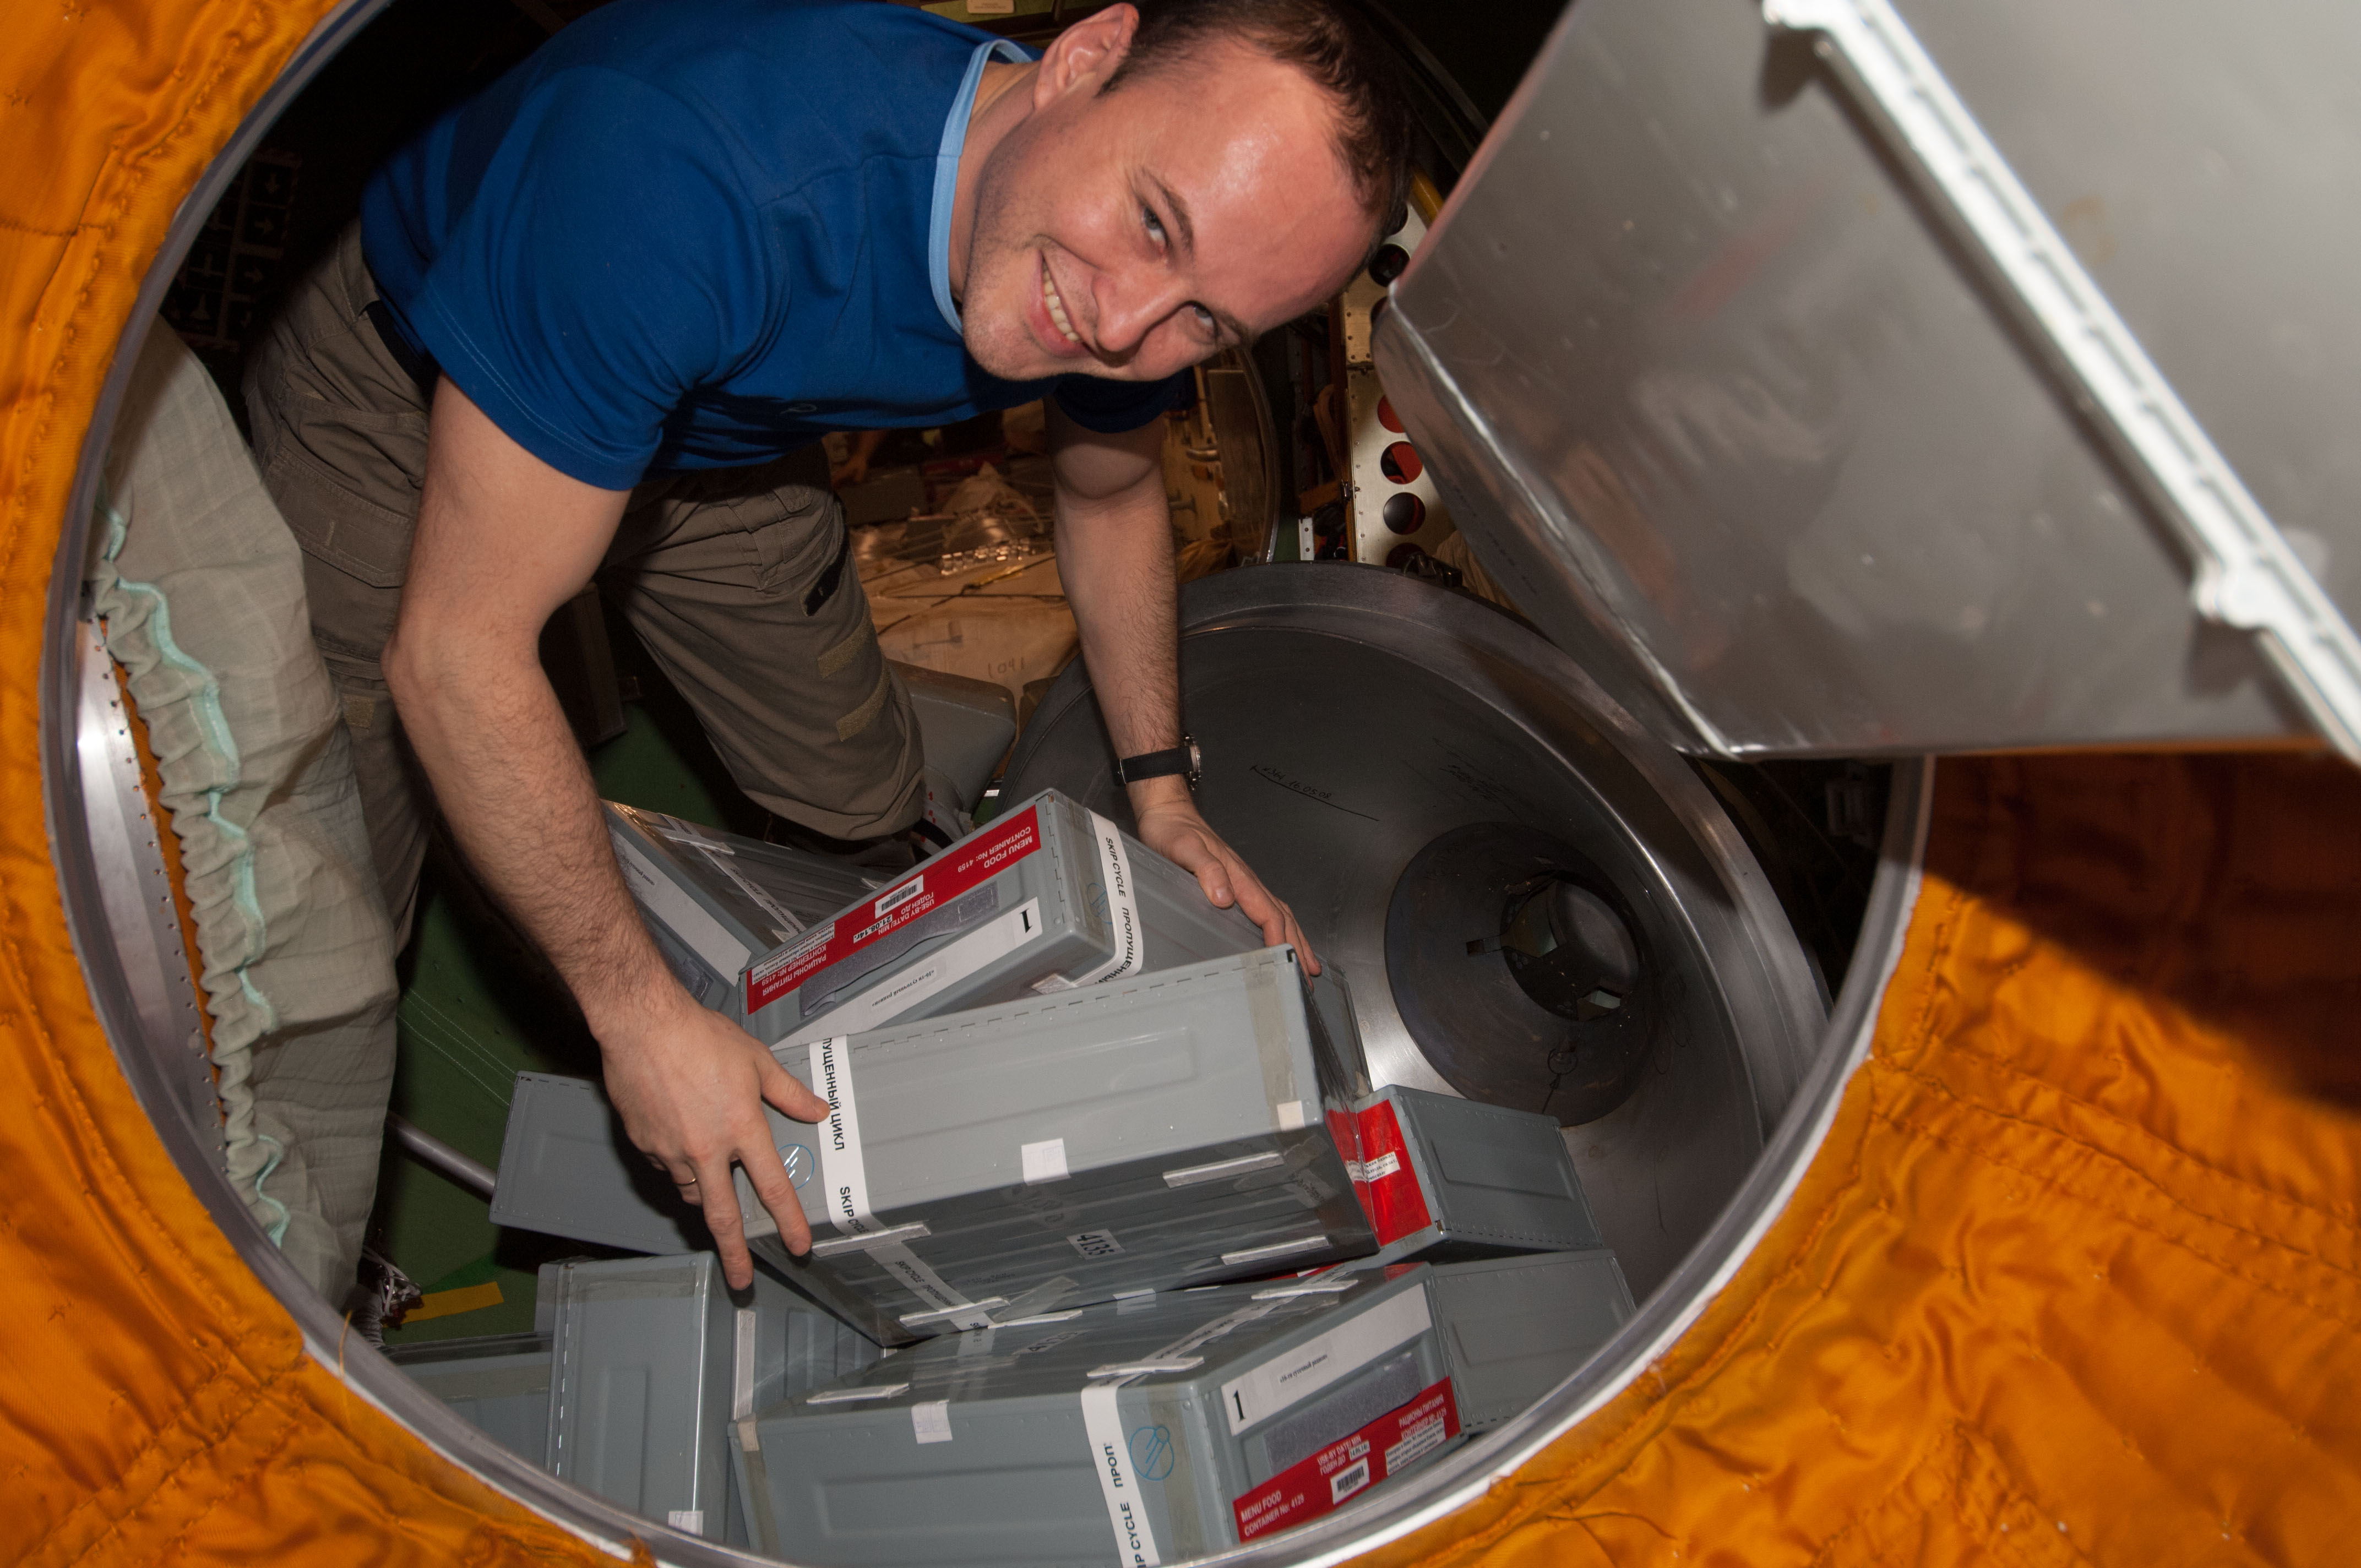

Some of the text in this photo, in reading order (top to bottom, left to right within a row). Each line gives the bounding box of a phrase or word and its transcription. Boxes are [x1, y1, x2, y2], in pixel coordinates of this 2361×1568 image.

[957, 826, 1030, 872] CONTAINER No: 4159
[983, 835, 1032, 868] MENU FOOD
[1105, 837, 1126, 897] SKIP CYCLE
[901, 903, 911, 914] ДО
[911, 891, 933, 908] ГОДЕН
[855, 916, 890, 940] 21.08.14г.
[878, 898, 934, 935] USE-BY DATE/ MIN
[1020, 908, 1035, 934] 1
[787, 944, 826, 972] КОНТЕЙНЕР
[761, 973, 776, 986] 4159
[762, 953, 826, 996] РАЦИОНЫ ПИТАНИЯ
[893, 978, 918, 996] суточный
[830, 1112, 845, 1151] ЦИКЛ
[839, 1186, 855, 1217] SKIP
[1234, 1390, 1245, 1422] 1
[1399, 1395, 1444, 1429] РАЦИОНЫ ПИТАНИЯ
[1103, 1444, 1123, 1488] ПРОП
[1241, 1491, 1282, 1523] MENU FOOD
[1244, 1509, 1279, 1537] CONTAINER
[1291, 1494, 1304, 1509] 4129
[1119, 1502, 1141, 1549] CYCLE
